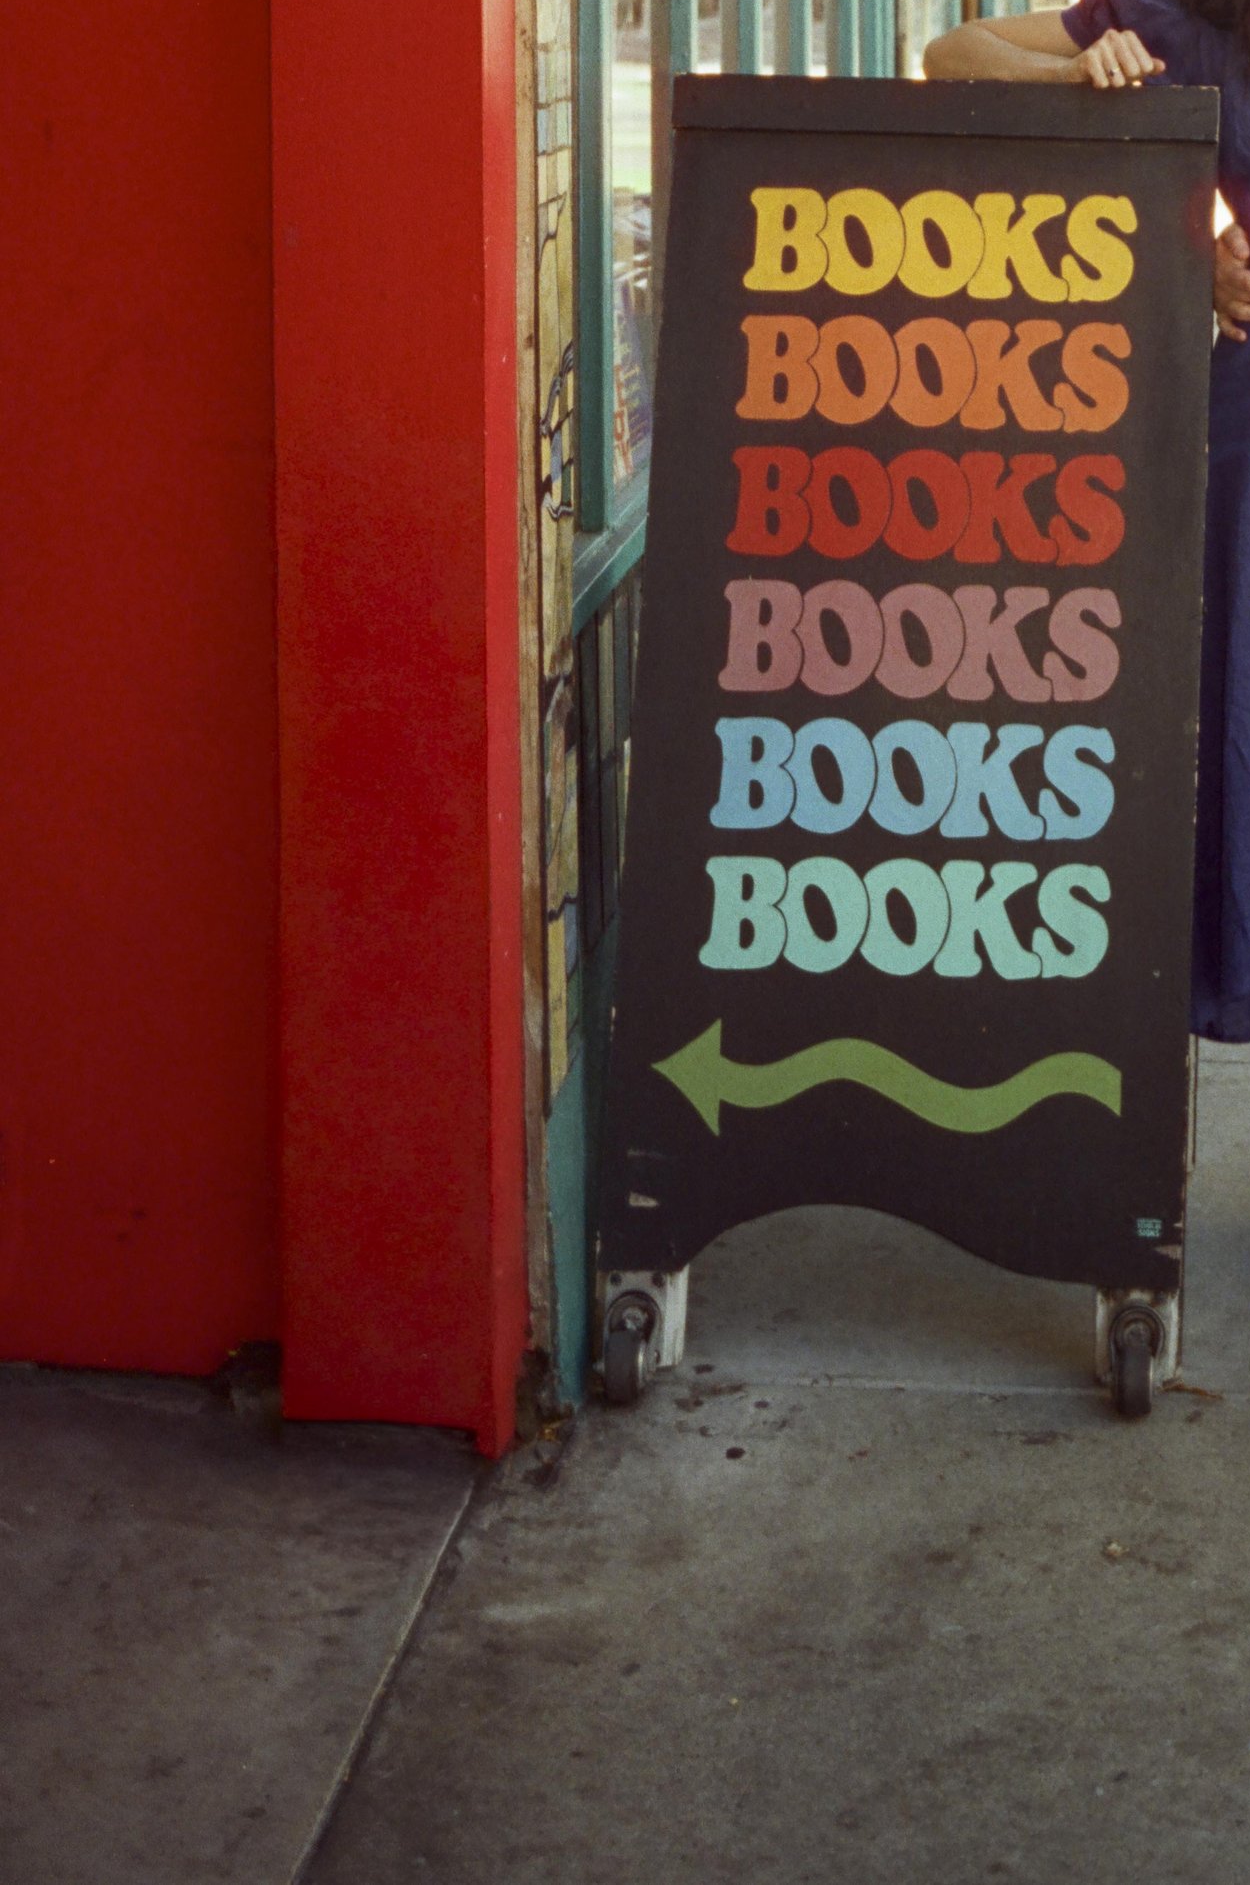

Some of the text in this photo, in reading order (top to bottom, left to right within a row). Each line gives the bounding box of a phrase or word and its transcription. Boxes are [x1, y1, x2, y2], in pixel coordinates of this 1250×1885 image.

[742, 187, 1139, 304] BOOKS
[734, 314, 1132, 433] BOOKS
[726, 446, 1126, 567] BOOKS
[718, 578, 1122, 703] BOOKS
[709, 716, 1116, 841] BOOKS
[699, 856, 1112, 980] BOOKS
